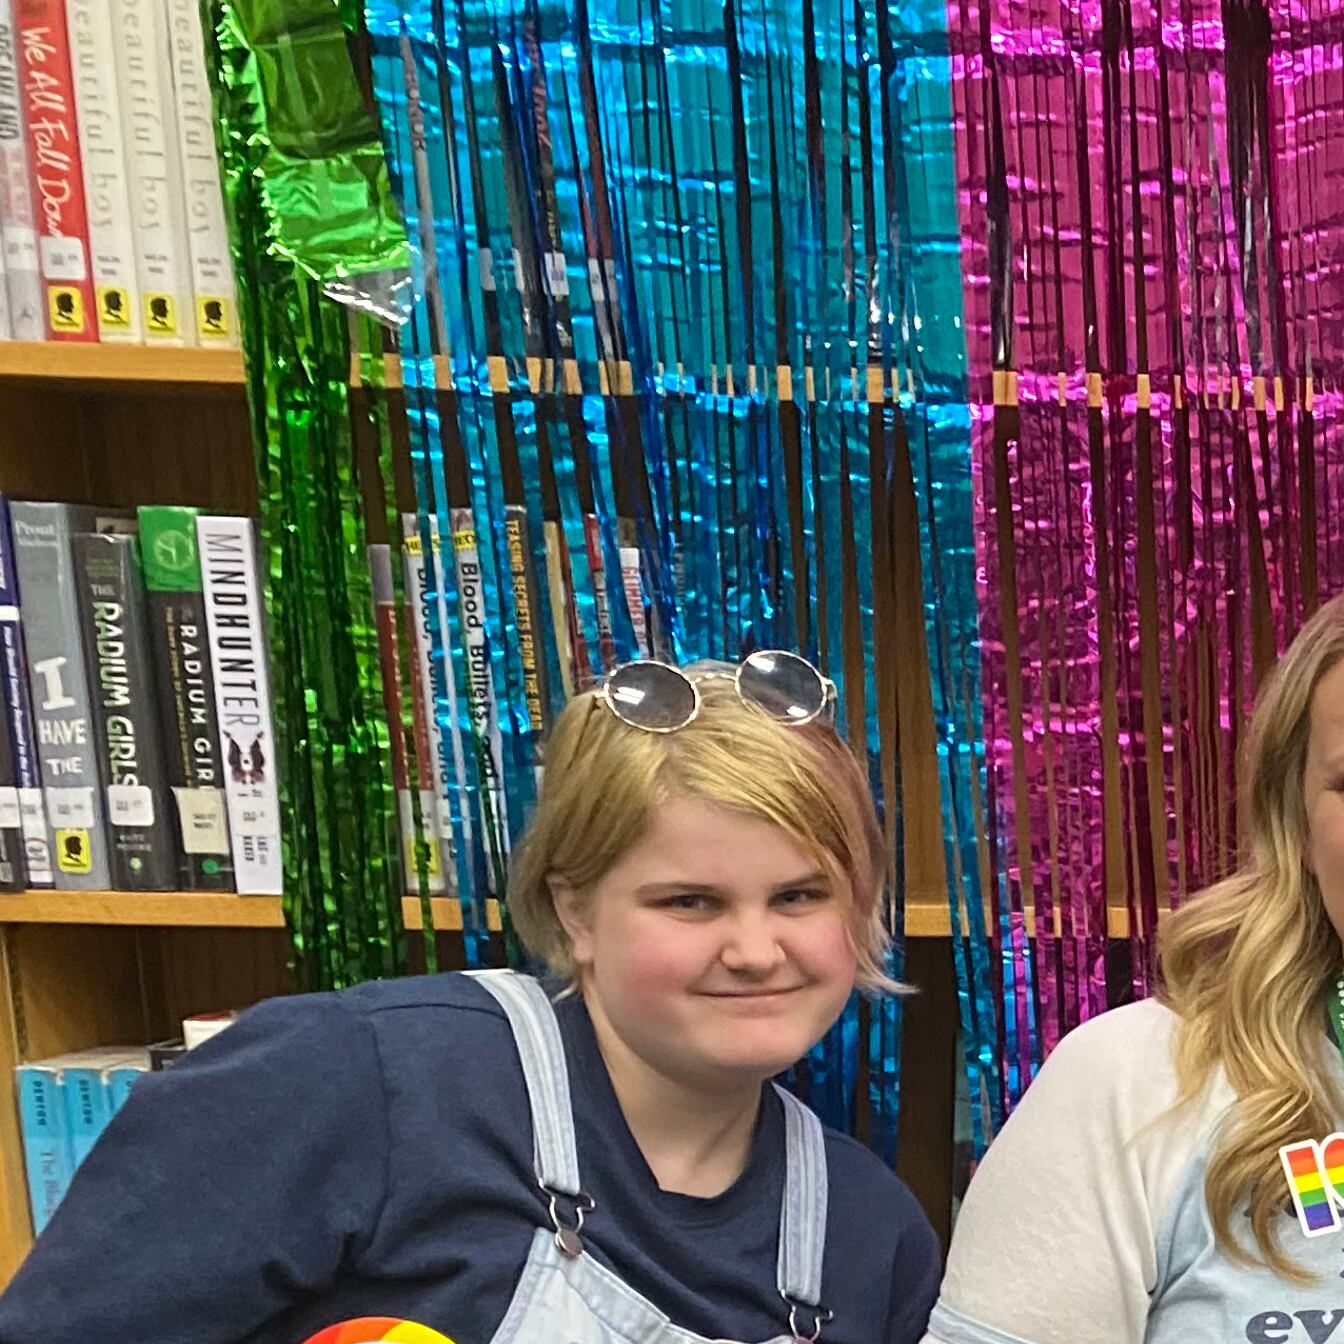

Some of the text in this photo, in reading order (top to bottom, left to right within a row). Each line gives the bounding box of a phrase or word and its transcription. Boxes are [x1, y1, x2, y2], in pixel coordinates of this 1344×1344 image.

[21, 27, 56, 64] We
[25, 71, 66, 113] All
[29, 117, 72, 171] Fall
[460, 562, 483, 636] Blood,
[92, 601, 131, 707] RADIUM
[205, 533, 260, 726] MINDHUNTER
[34, 656, 75, 711] I
[180, 624, 207, 724] RADIUM
[38, 719, 87, 746] HAVE
[106, 715, 139, 786] GIRLS
[46, 755, 83, 776] THE
